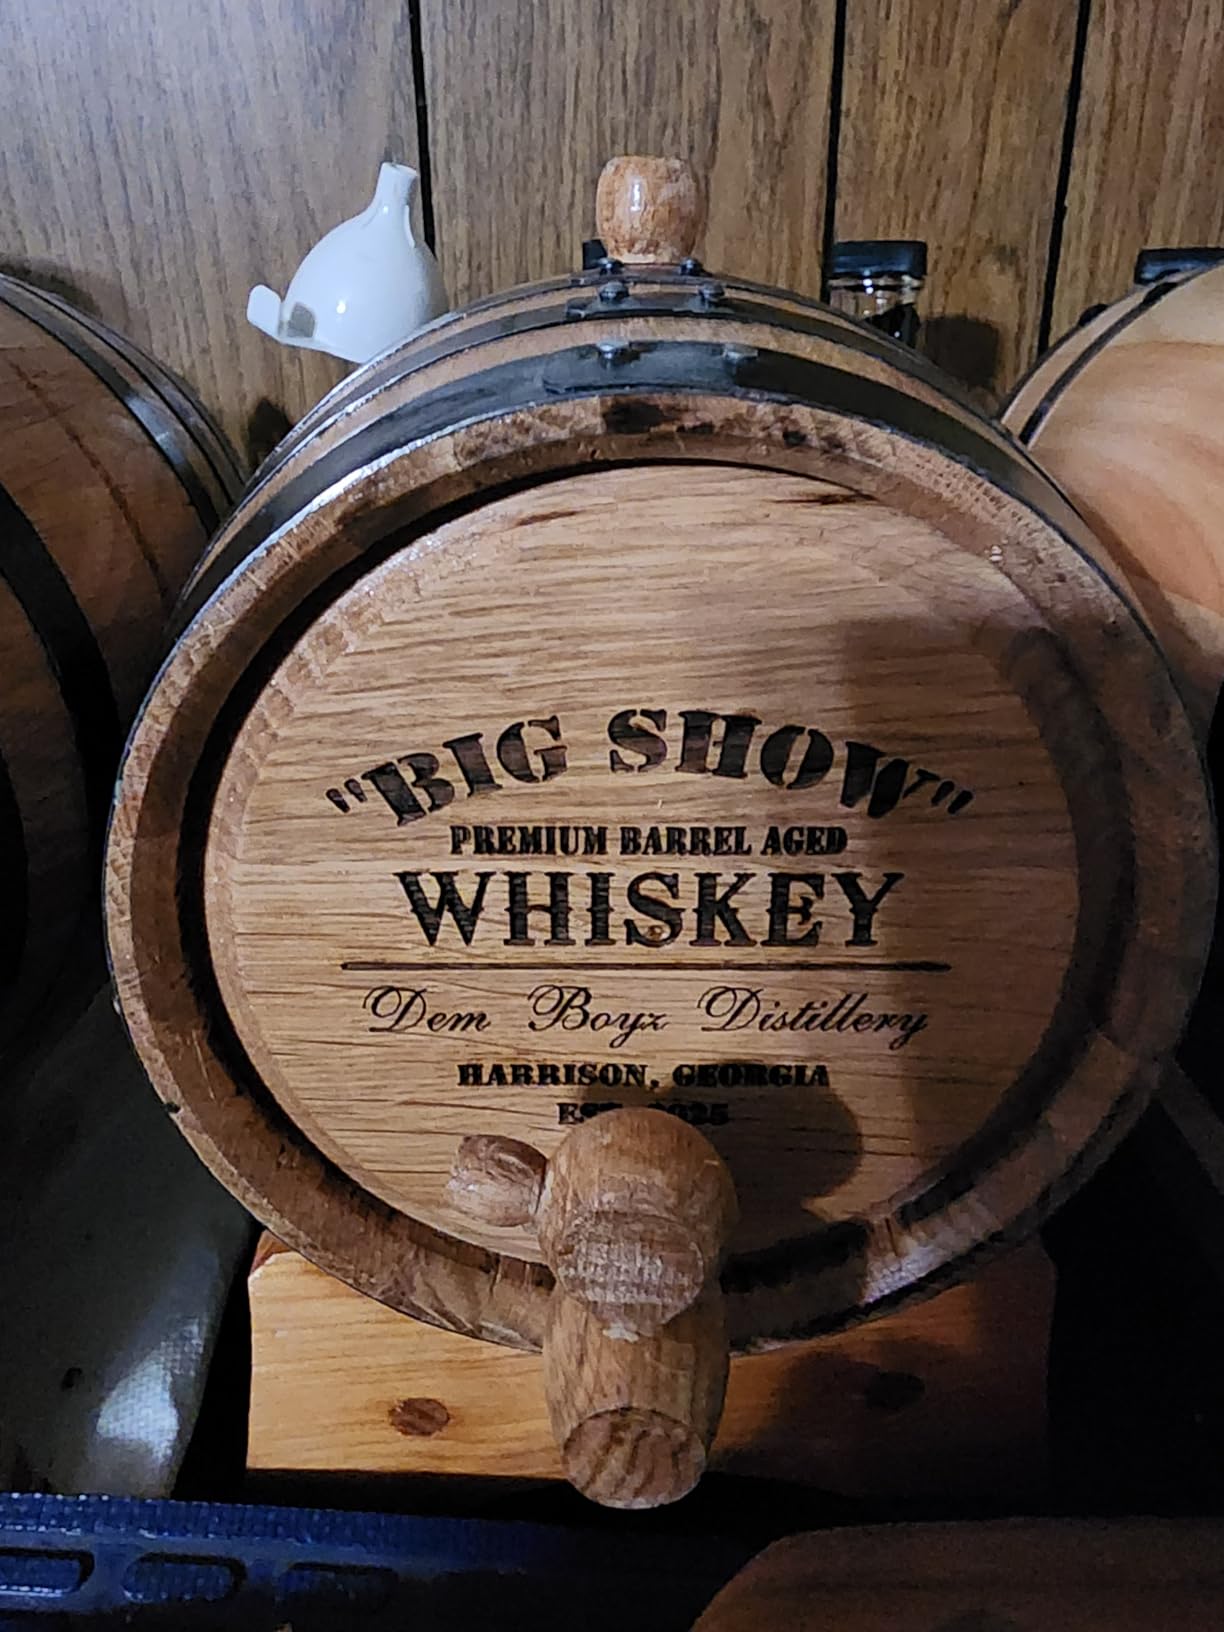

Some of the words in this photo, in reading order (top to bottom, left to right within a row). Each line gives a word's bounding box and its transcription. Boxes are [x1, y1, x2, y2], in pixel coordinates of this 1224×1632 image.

[326, 716, 567, 827] "BIG
[606, 708, 973, 819] SHOW"
[450, 825, 608, 855] PREMIUM
[619, 826, 752, 856] BARREL
[760, 826, 849, 855] AGED
[393, 871, 904, 947] WHISKEY
[362, 984, 492, 1033] Dem
[527, 983, 669, 1050] Boyz
[696, 985, 930, 1051] Distillery
[457, 1063, 660, 1089] HARRISON,
[672, 1063, 830, 1088] GEORGIA
